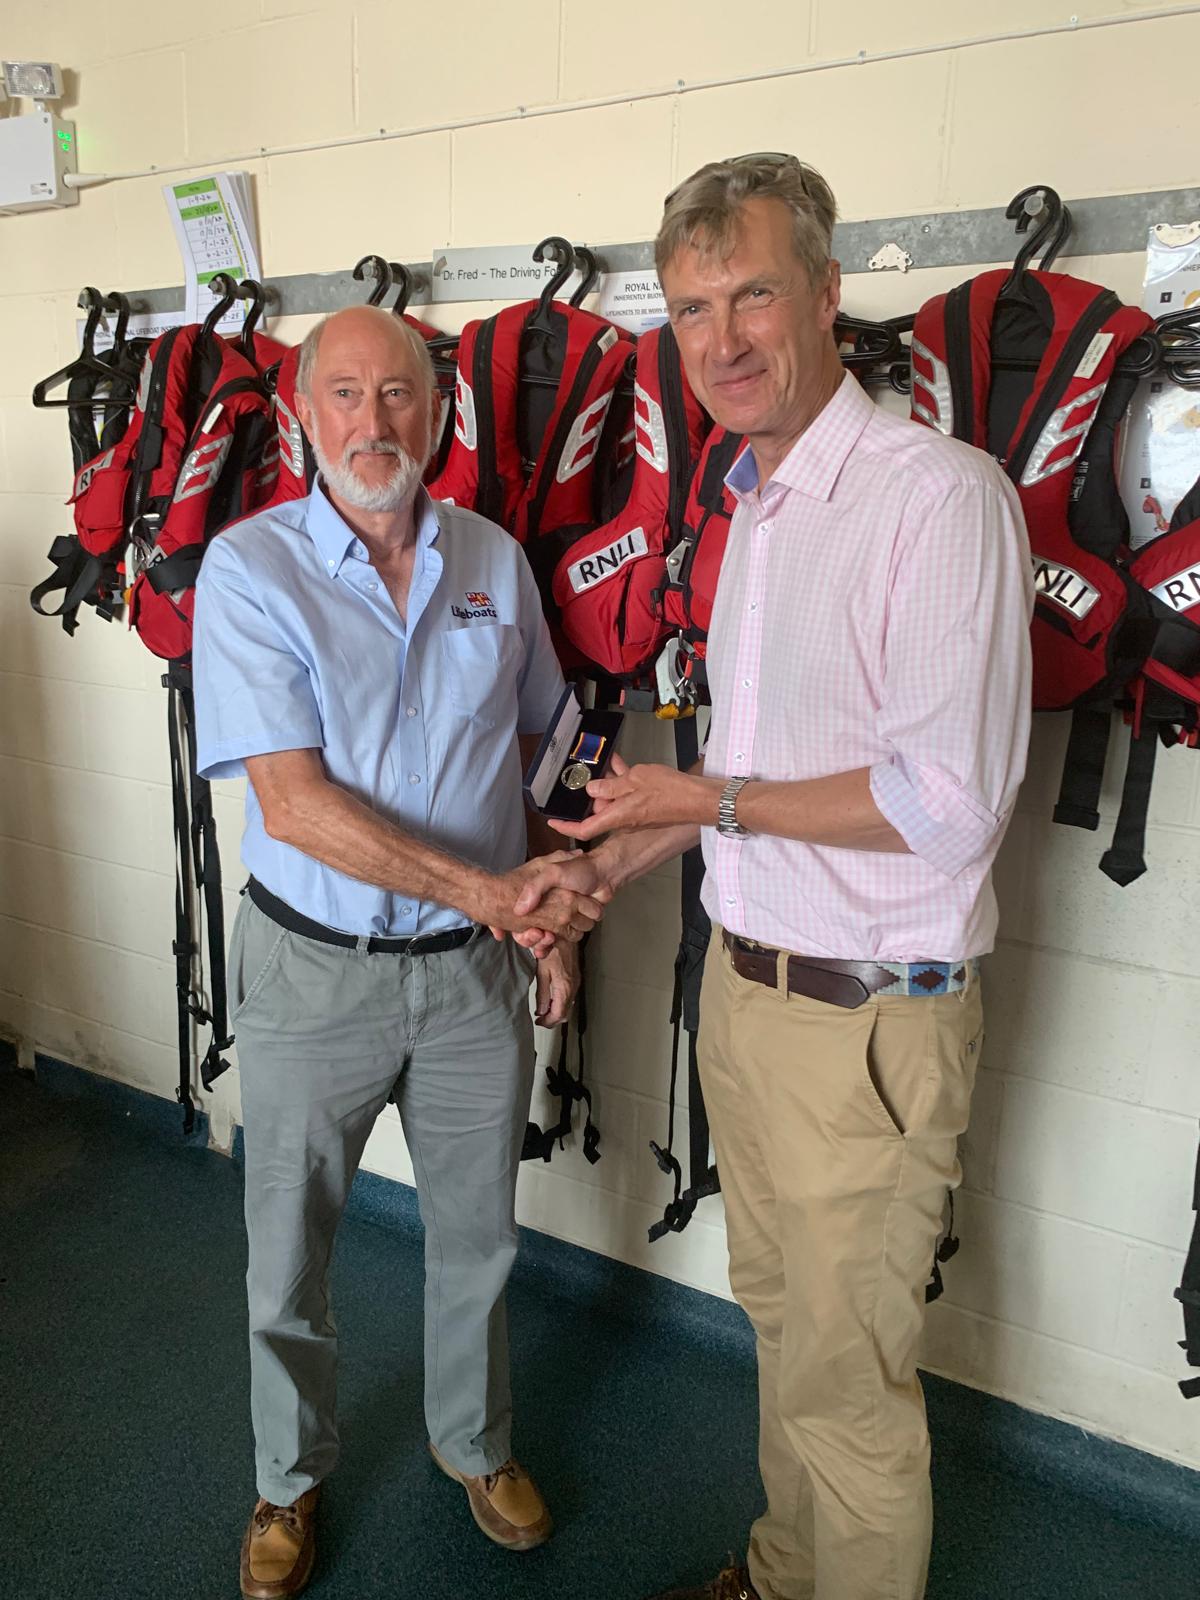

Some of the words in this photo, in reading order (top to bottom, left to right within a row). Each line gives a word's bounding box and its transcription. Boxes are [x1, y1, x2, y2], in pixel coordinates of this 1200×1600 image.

[443, 270, 454, 280] Dr.
[457, 269, 478, 280] Fred
[490, 267, 507, 279] The
[510, 266, 541, 279] Driving
[544, 266, 558, 276] Fo
[625, 283, 650, 292] ROYAL
[579, 534, 635, 585] RNLI
[1031, 559, 1088, 608] NLI
